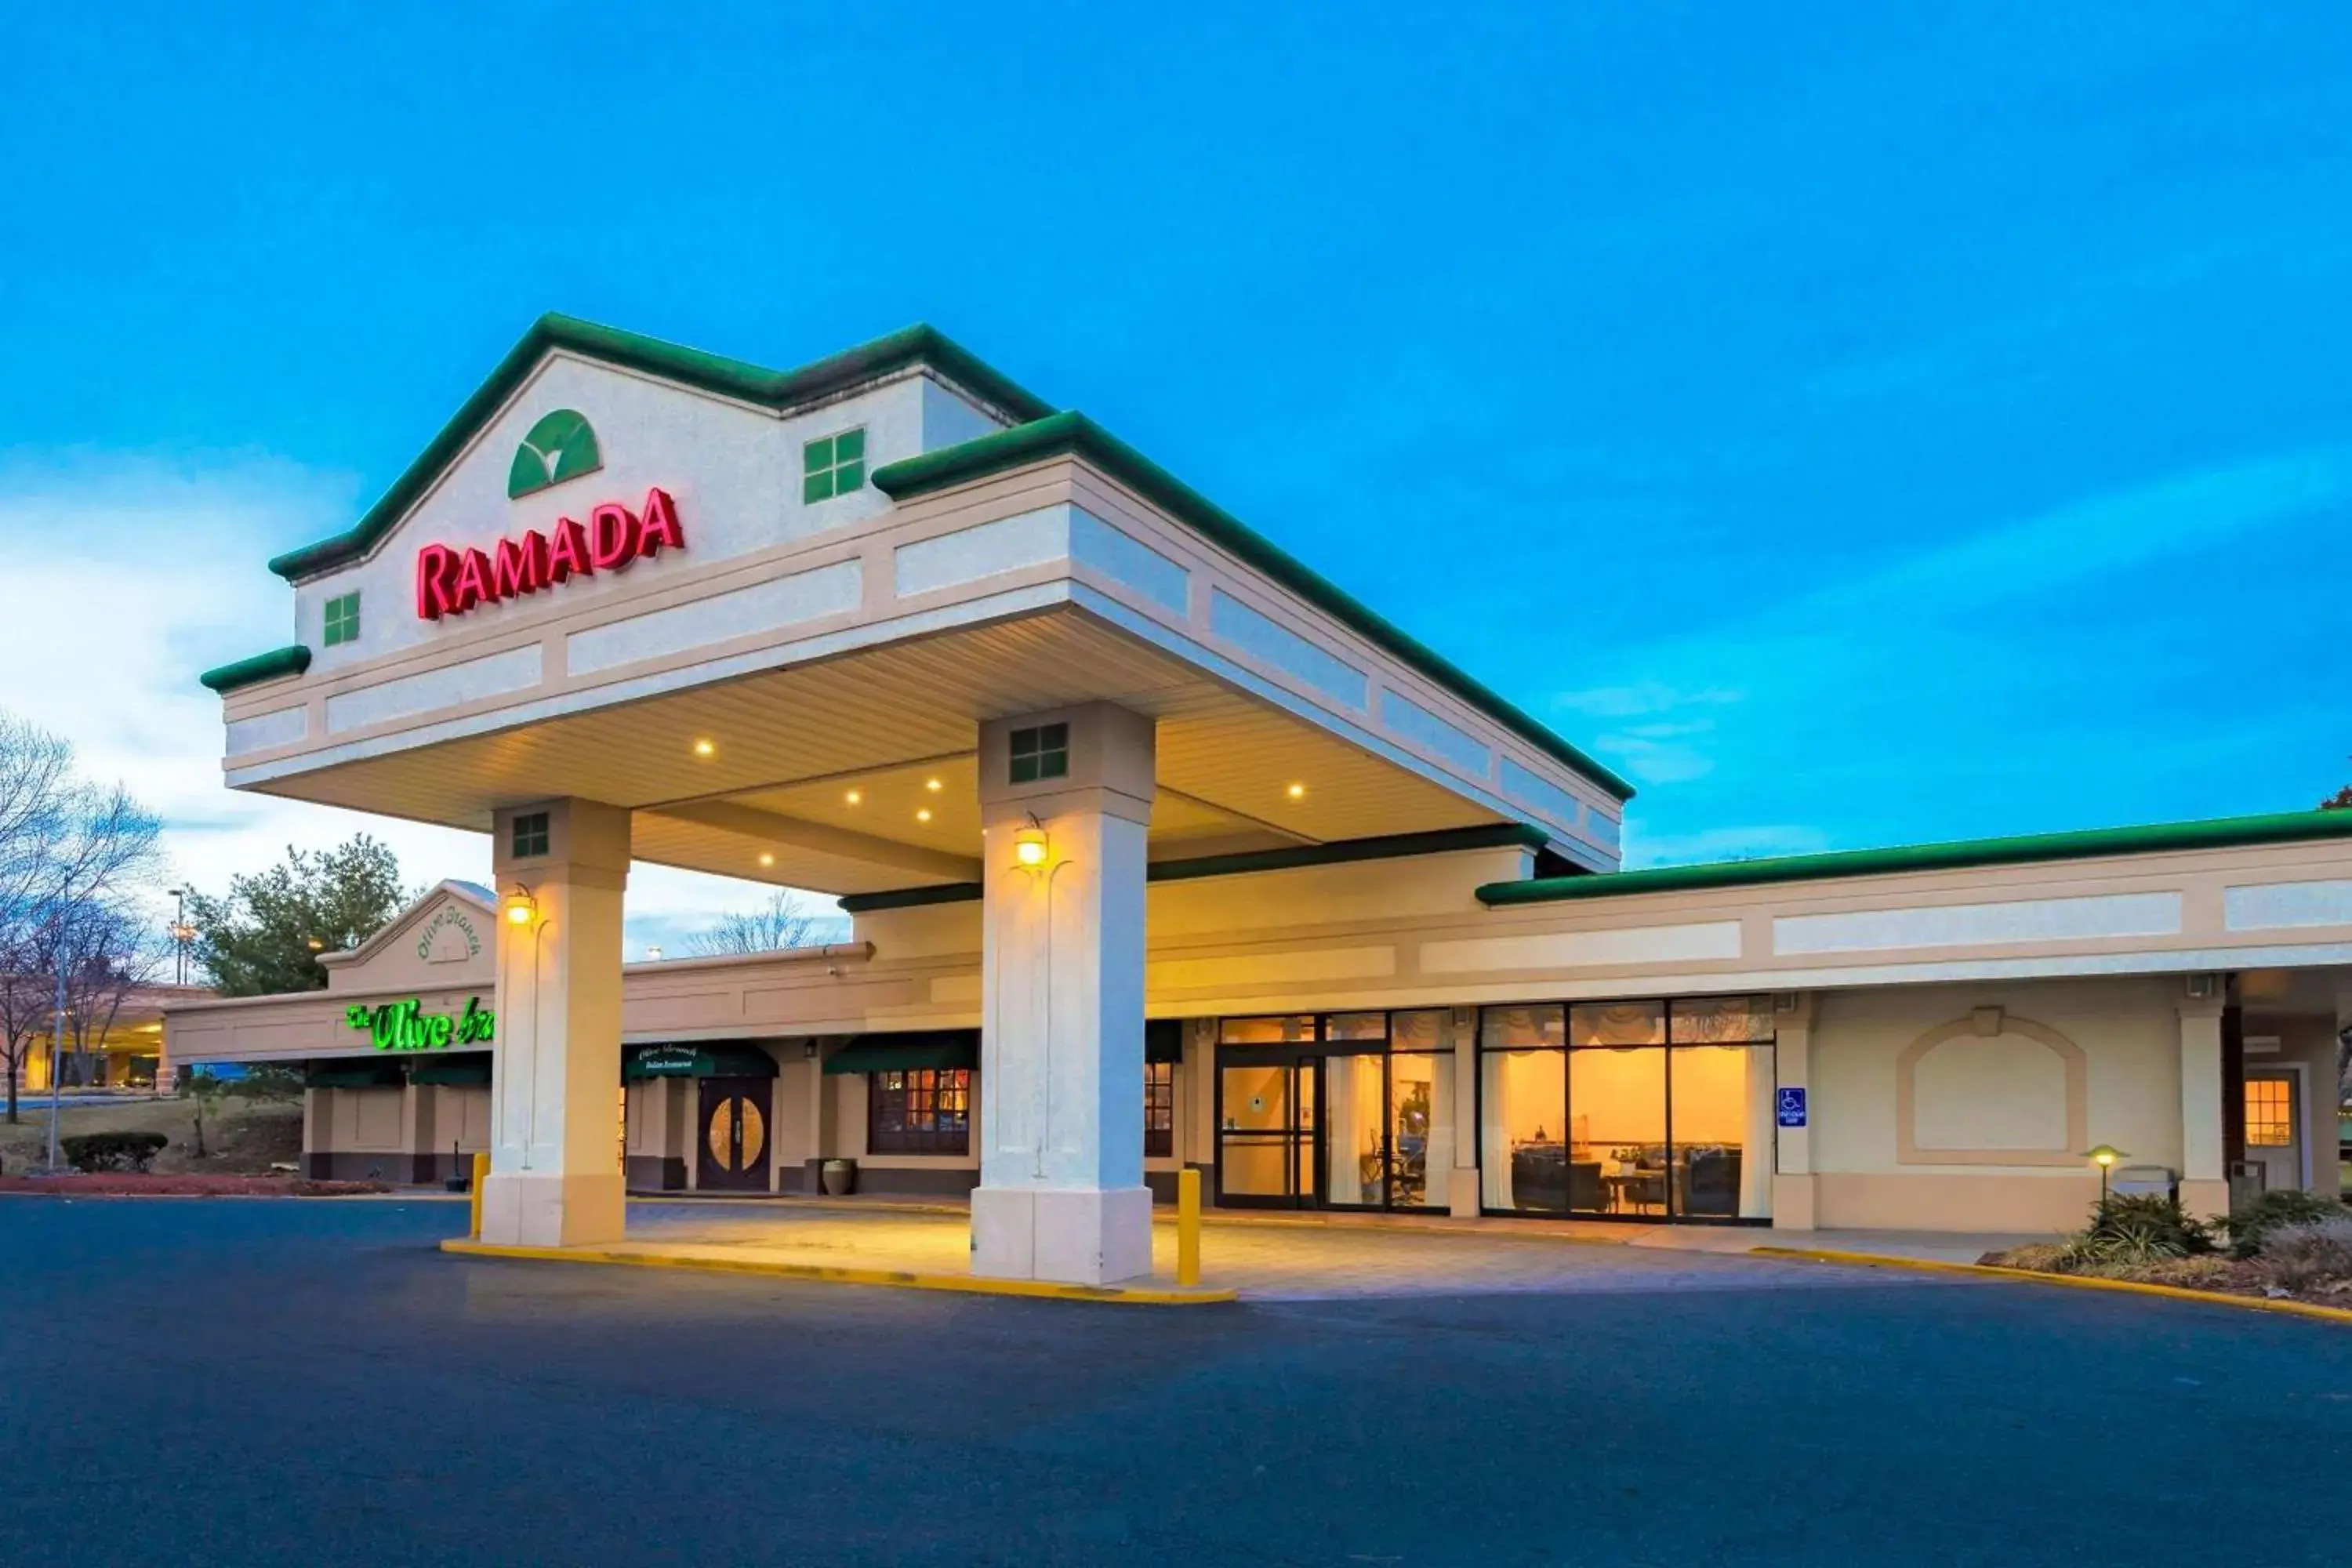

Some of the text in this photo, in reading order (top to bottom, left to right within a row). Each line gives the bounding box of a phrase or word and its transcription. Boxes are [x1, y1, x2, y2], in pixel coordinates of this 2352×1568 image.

[417, 486, 685, 621] RAMADA
[418, 913, 444, 960] Olive
[372, 997, 454, 1049] Olive
